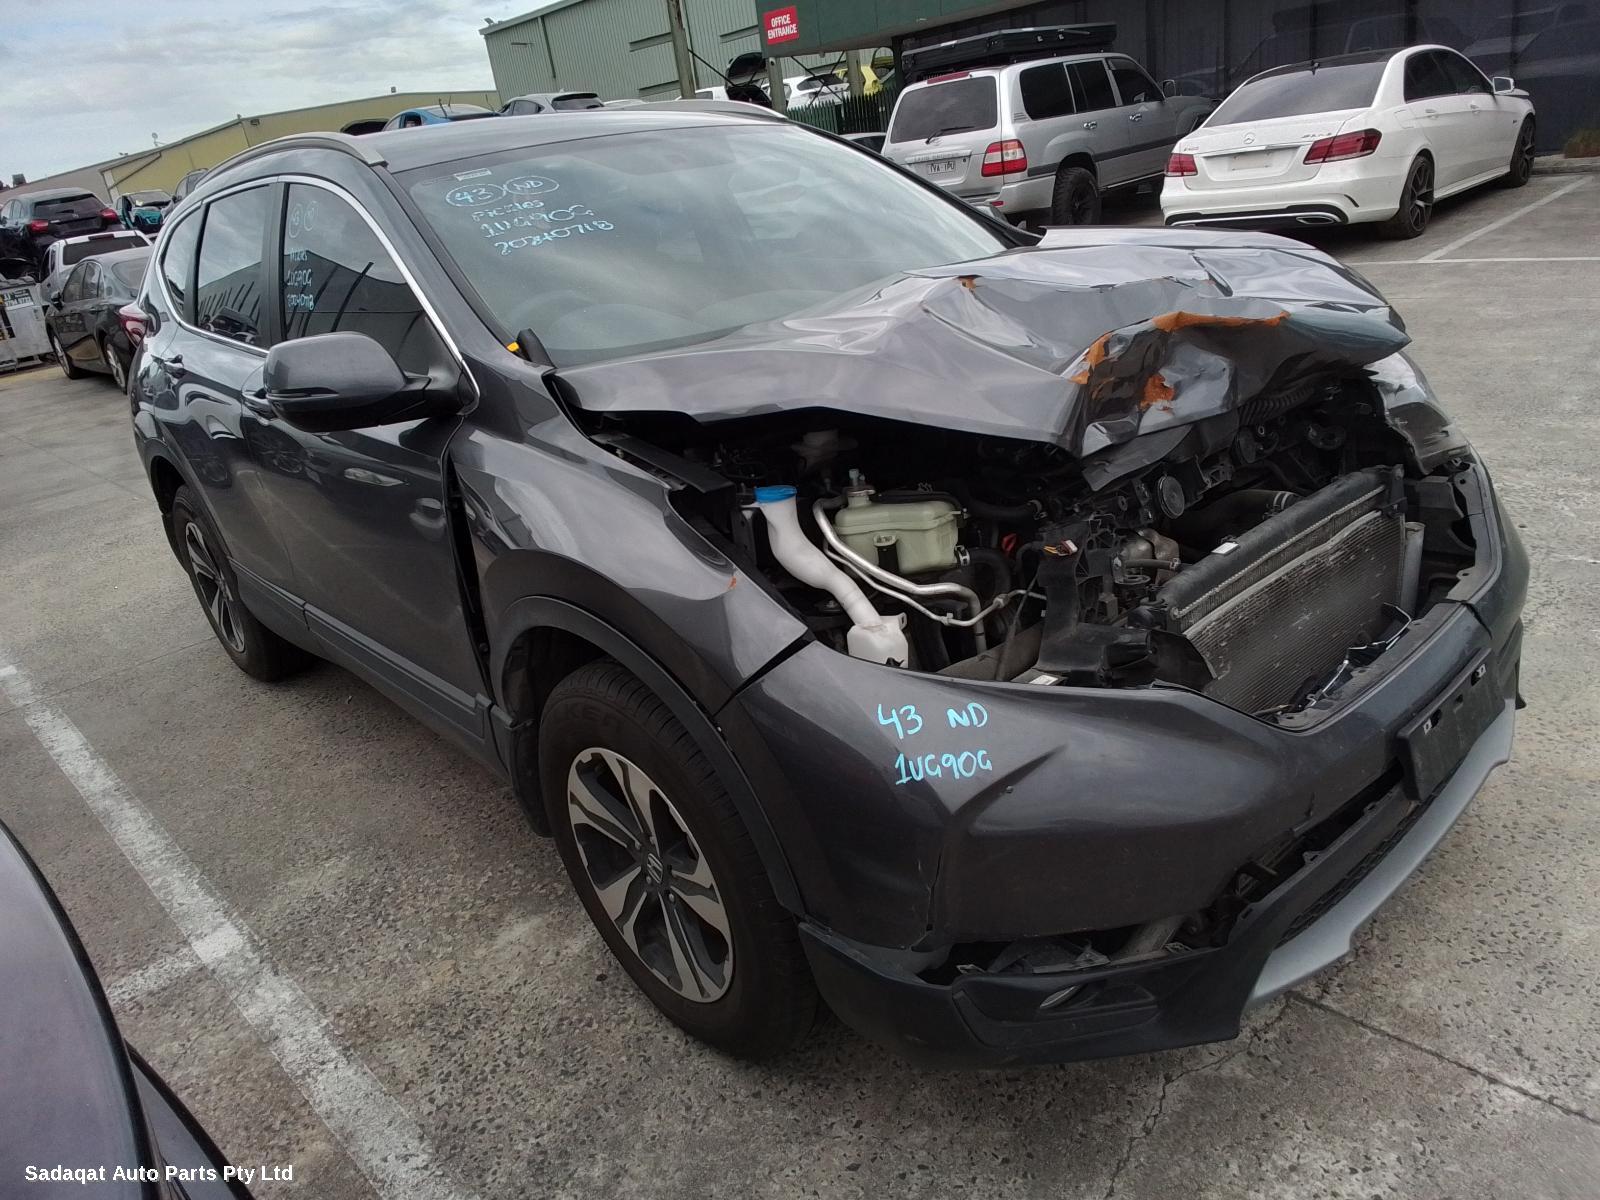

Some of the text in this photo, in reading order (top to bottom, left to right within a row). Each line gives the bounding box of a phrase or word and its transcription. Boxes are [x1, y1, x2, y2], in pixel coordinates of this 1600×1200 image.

[767, 24, 798, 40] ENTRANCE
[771, 14, 791, 27] OFFICE
[877, 702, 988, 740] 43 ND
[894, 749, 993, 785] 1UG90G
